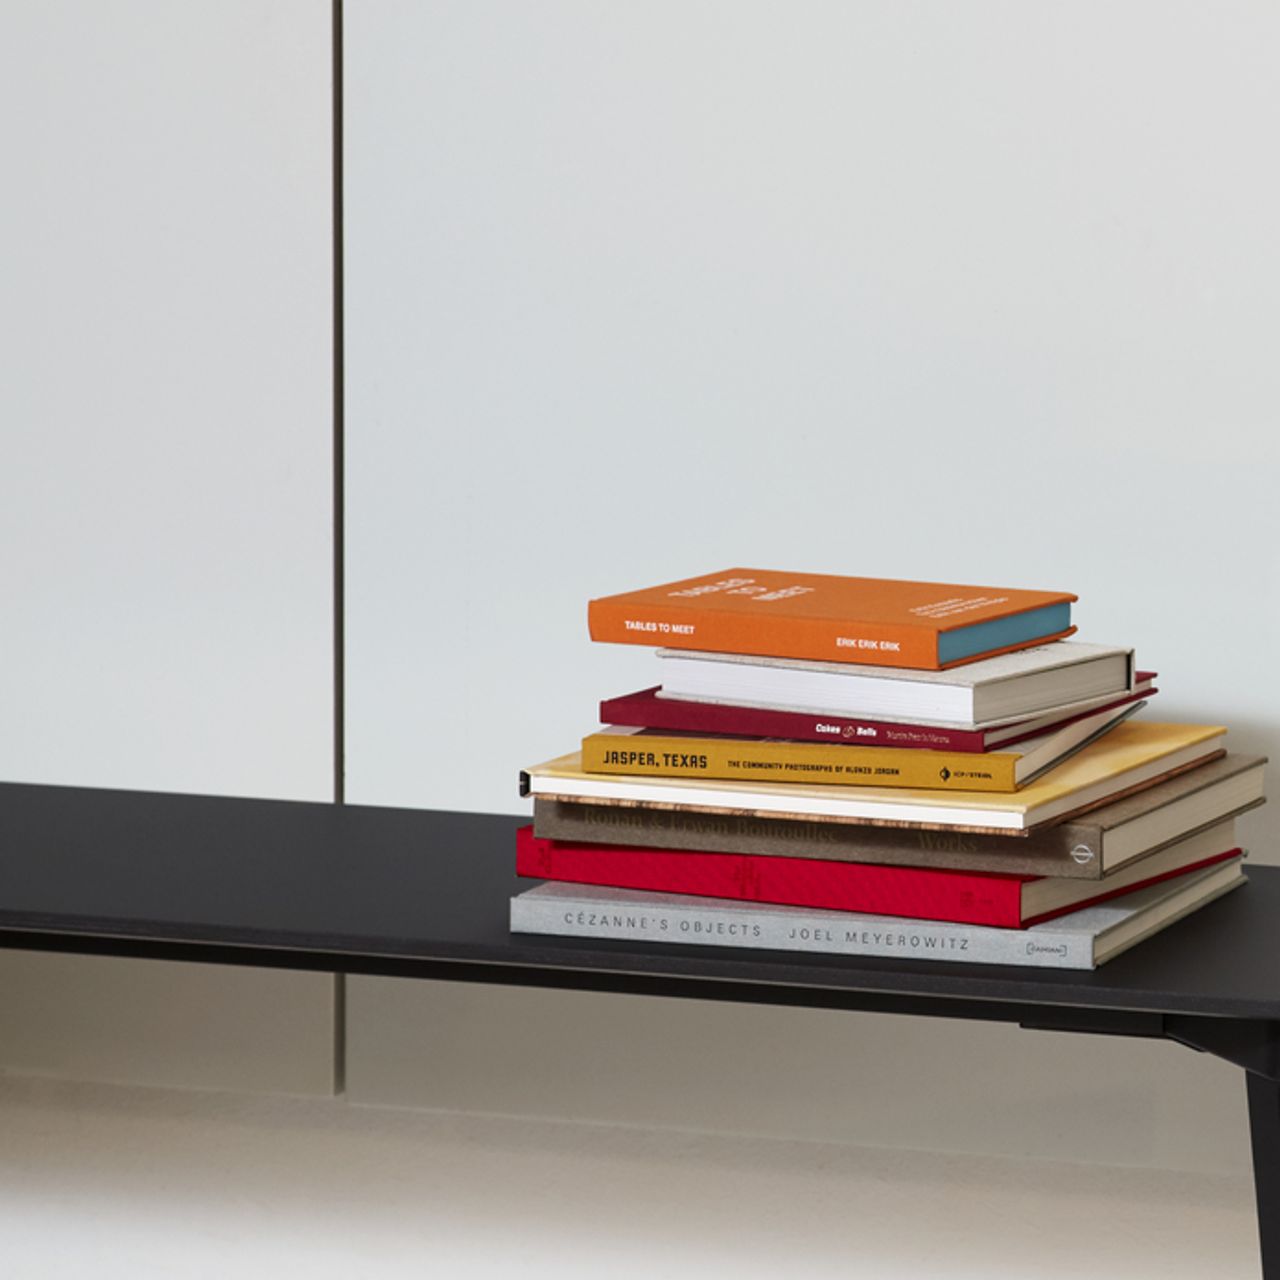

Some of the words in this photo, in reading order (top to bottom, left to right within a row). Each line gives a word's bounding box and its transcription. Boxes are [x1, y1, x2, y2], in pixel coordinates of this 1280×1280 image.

[624, 620, 657, 632] TABLES
[658, 622, 671, 633] TO
[671, 624, 696, 635] MEET
[836, 637, 857, 648] ERIK
[858, 639, 878, 650] ERIK
[880, 641, 900, 652] ERIK
[603, 751, 660, 767] JASPER,
[663, 753, 708, 769] TEXAS
[728, 760, 740, 768] THE
[742, 761, 782, 770] COMMUNITY
[785, 763, 833, 773] PHOTOGRAPHS
[835, 765, 844, 773] OF
[917, 831, 978, 852] Works
[564, 912, 669, 930] CÉZANNE'S
[680, 921, 761, 937] OBJECTS
[789, 928, 833, 942] JOEL
[845, 932, 969, 951] MEYEROWITZ
